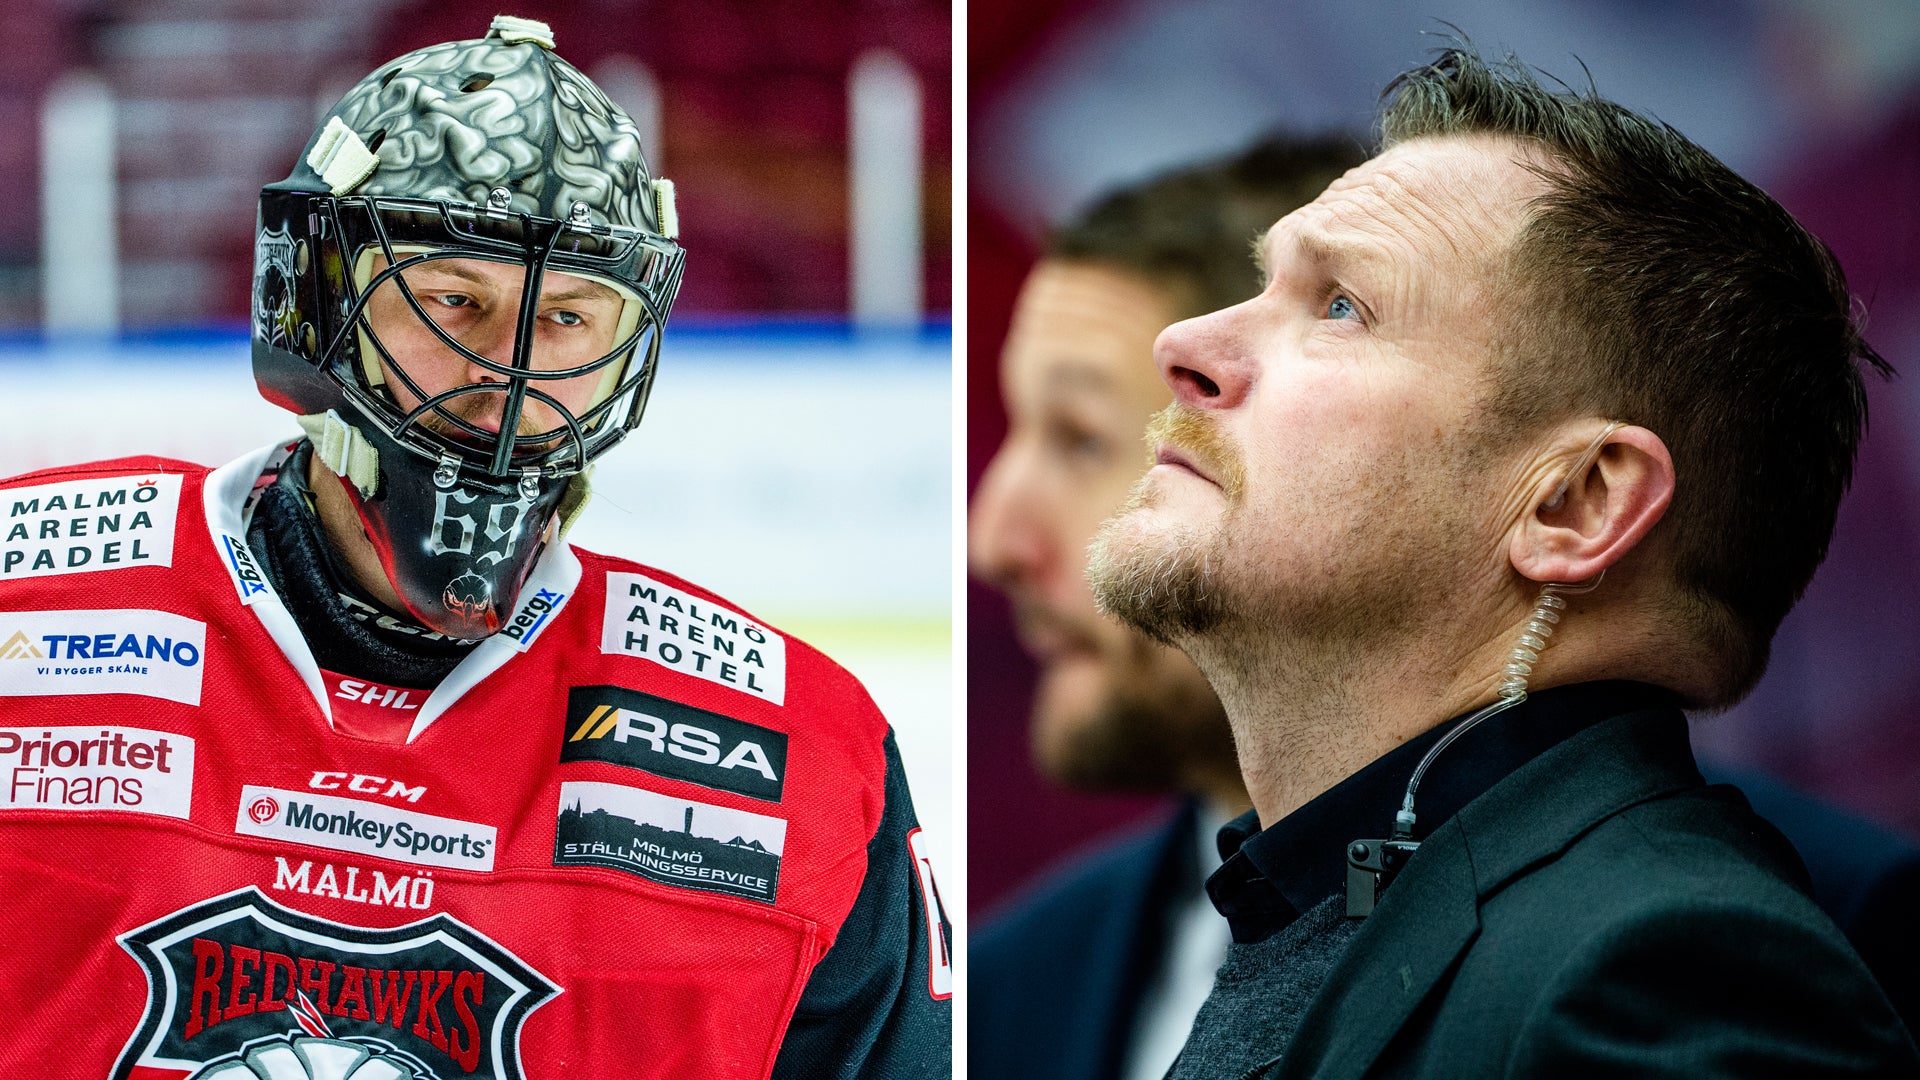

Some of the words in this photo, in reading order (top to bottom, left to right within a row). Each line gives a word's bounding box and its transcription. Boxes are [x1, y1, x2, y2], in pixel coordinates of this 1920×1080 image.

[6, 511, 153, 542] ARENA
[430, 488, 536, 565] 69
[4, 539, 150, 573] PADEL
[230, 536, 268, 594] bergx
[501, 588, 556, 641] bergx
[627, 605, 765, 668] ARENA
[38, 667, 49, 675] VI
[55, 667, 102, 675] BYGGER
[108, 664, 148, 675] SKÅNE
[42, 634, 199, 667] TREANO
[625, 631, 763, 692] HOTEL
[335, 679, 418, 710] SHL
[0, 731, 172, 774] Prioritet
[611, 708, 778, 781] RSA
[11, 768, 143, 806] Finans
[308, 771, 428, 803] CCM
[285, 801, 486, 859] MonkeySports
[633, 837, 702, 863] MALMÖ
[273, 857, 434, 909] MALMÖ
[564, 841, 769, 889] STÄLLNINGSSERVICE
[185, 937, 485, 1073] REDHAWKS
